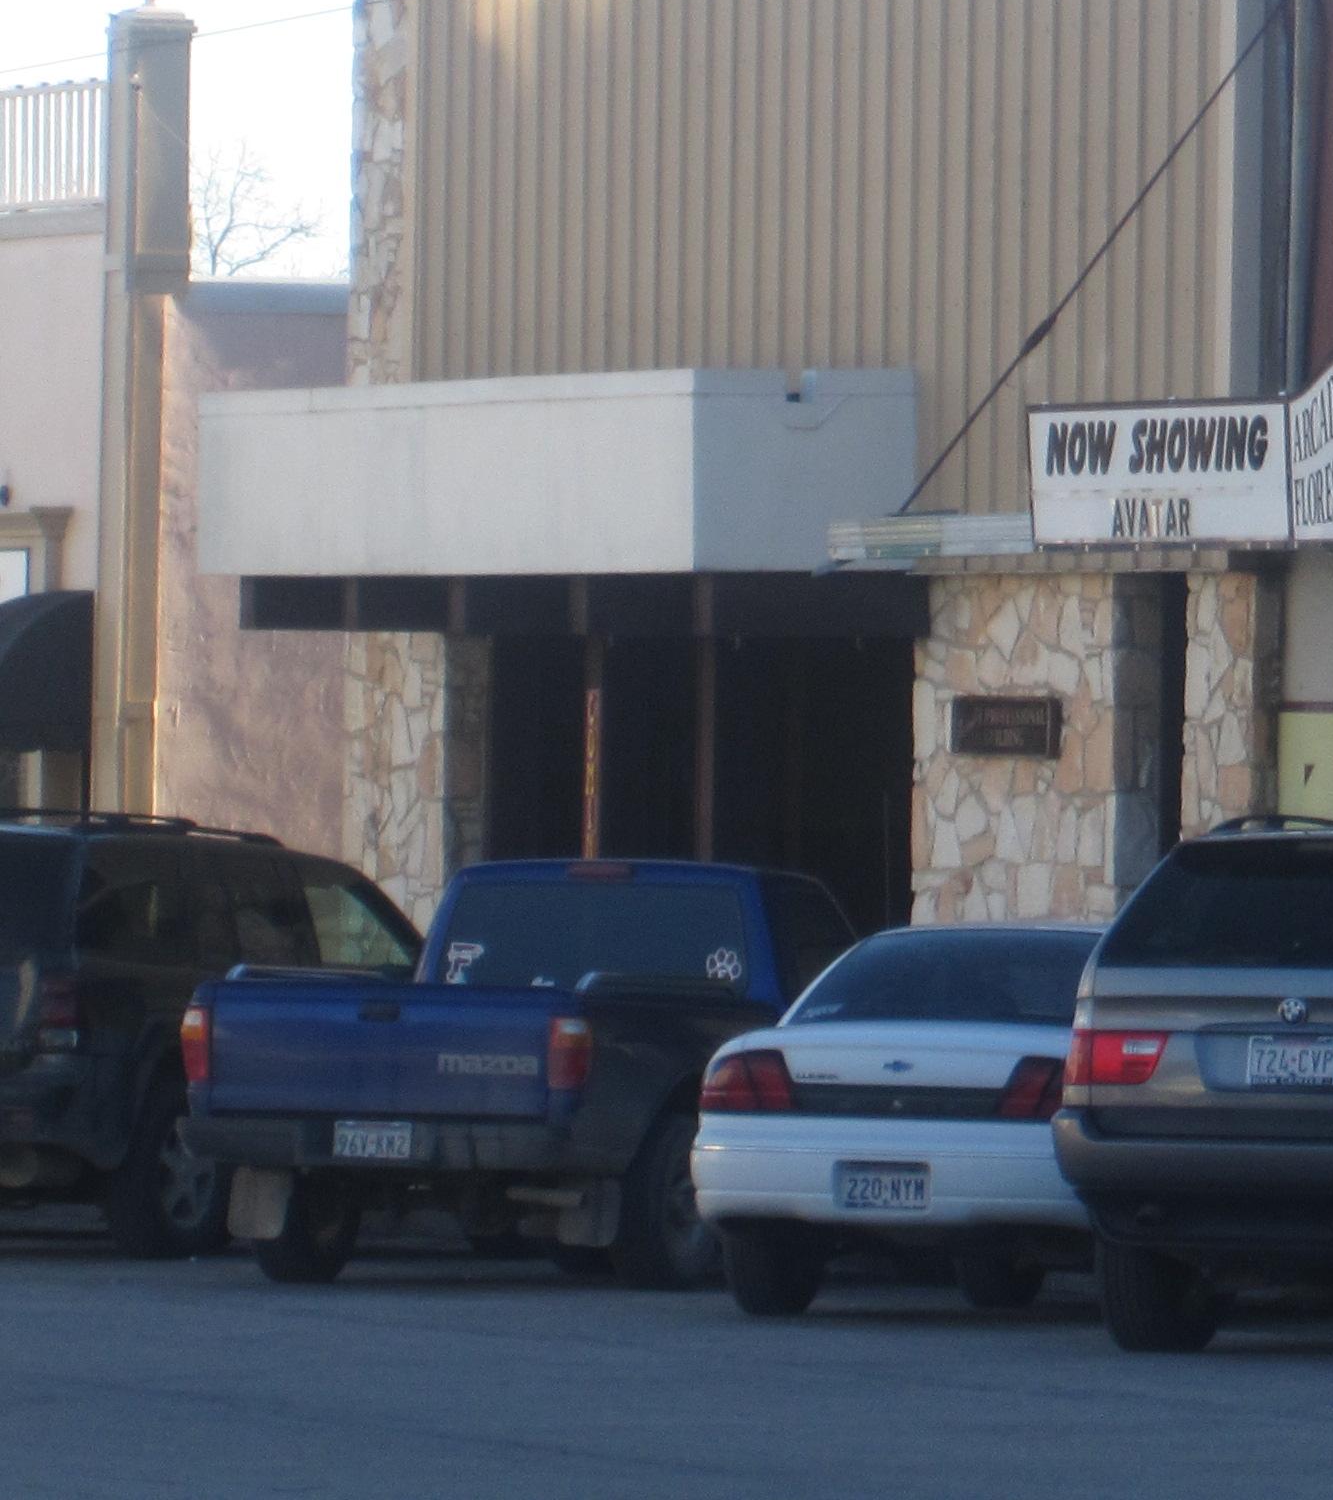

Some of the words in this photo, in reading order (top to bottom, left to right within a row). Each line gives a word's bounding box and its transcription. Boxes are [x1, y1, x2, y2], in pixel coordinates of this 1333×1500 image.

[1046, 420, 1117, 476] NOW
[1129, 415, 1268, 474] SHOWING
[1112, 498, 1190, 537] AVATAR
